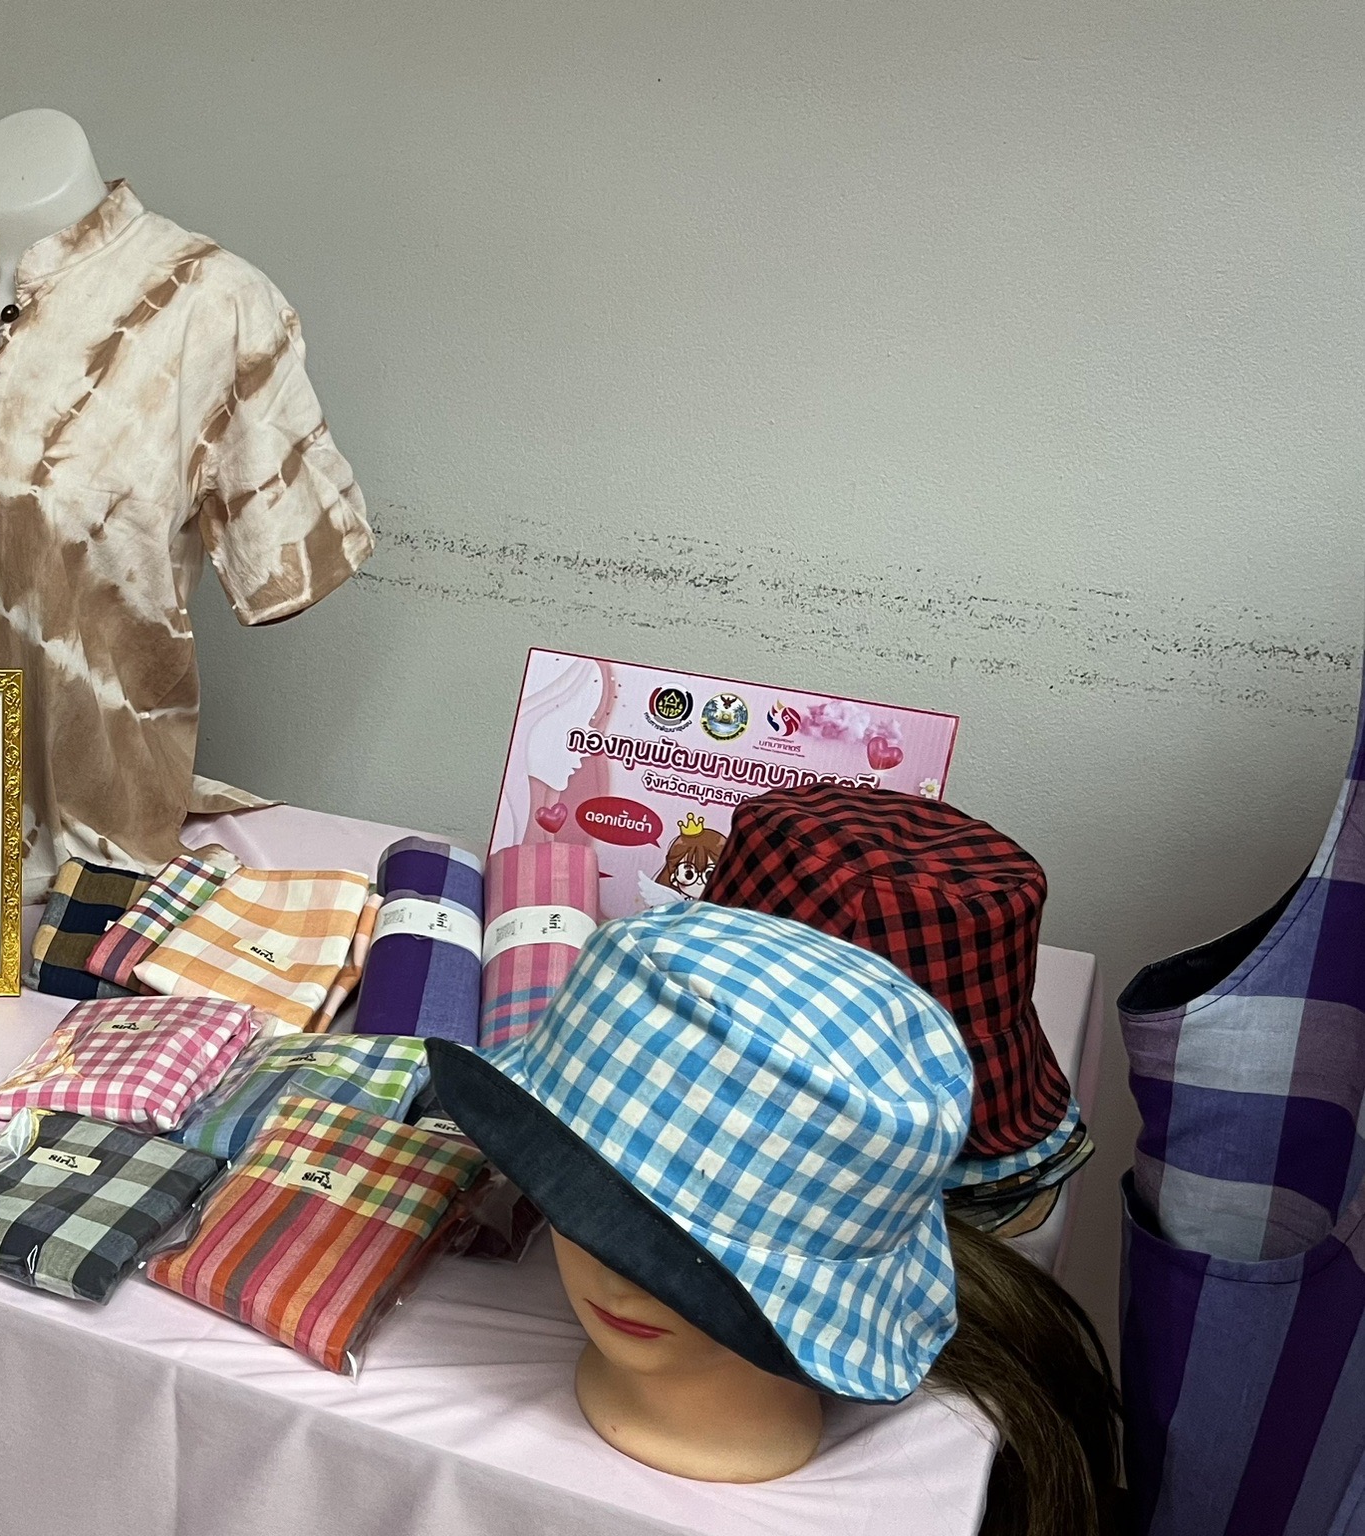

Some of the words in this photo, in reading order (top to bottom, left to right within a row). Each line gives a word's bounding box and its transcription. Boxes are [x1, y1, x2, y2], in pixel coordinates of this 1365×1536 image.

[585, 810, 652, 833] ดอกเบี้ยต่ำ
